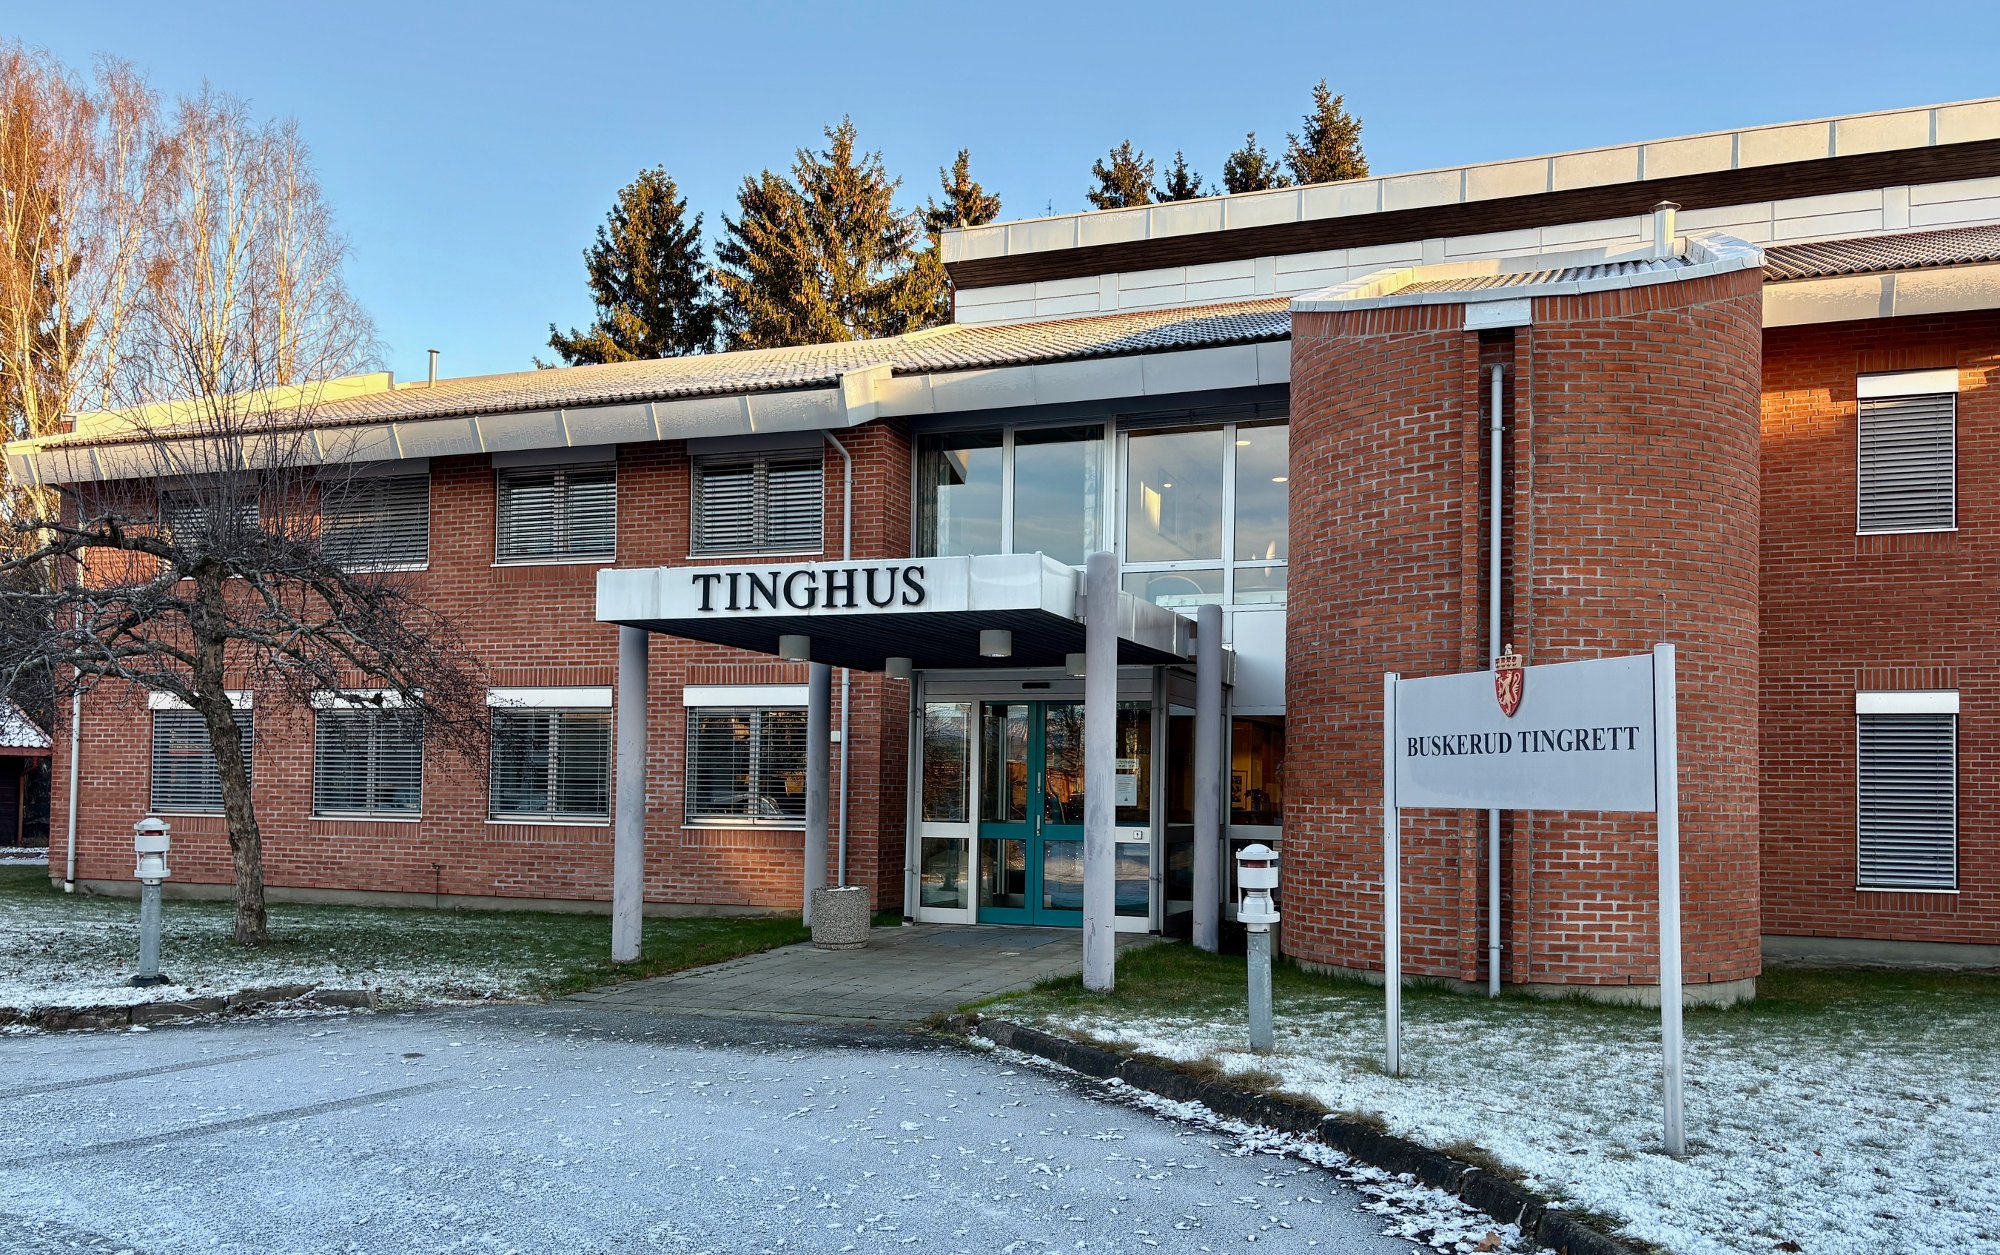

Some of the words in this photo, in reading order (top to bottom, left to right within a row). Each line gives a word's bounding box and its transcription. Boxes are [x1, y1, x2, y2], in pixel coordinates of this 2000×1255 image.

[692, 565, 926, 612] TINGHUS
[1407, 732, 1512, 757] BUSKERUD
[1517, 726, 1640, 753] TINGRETT
